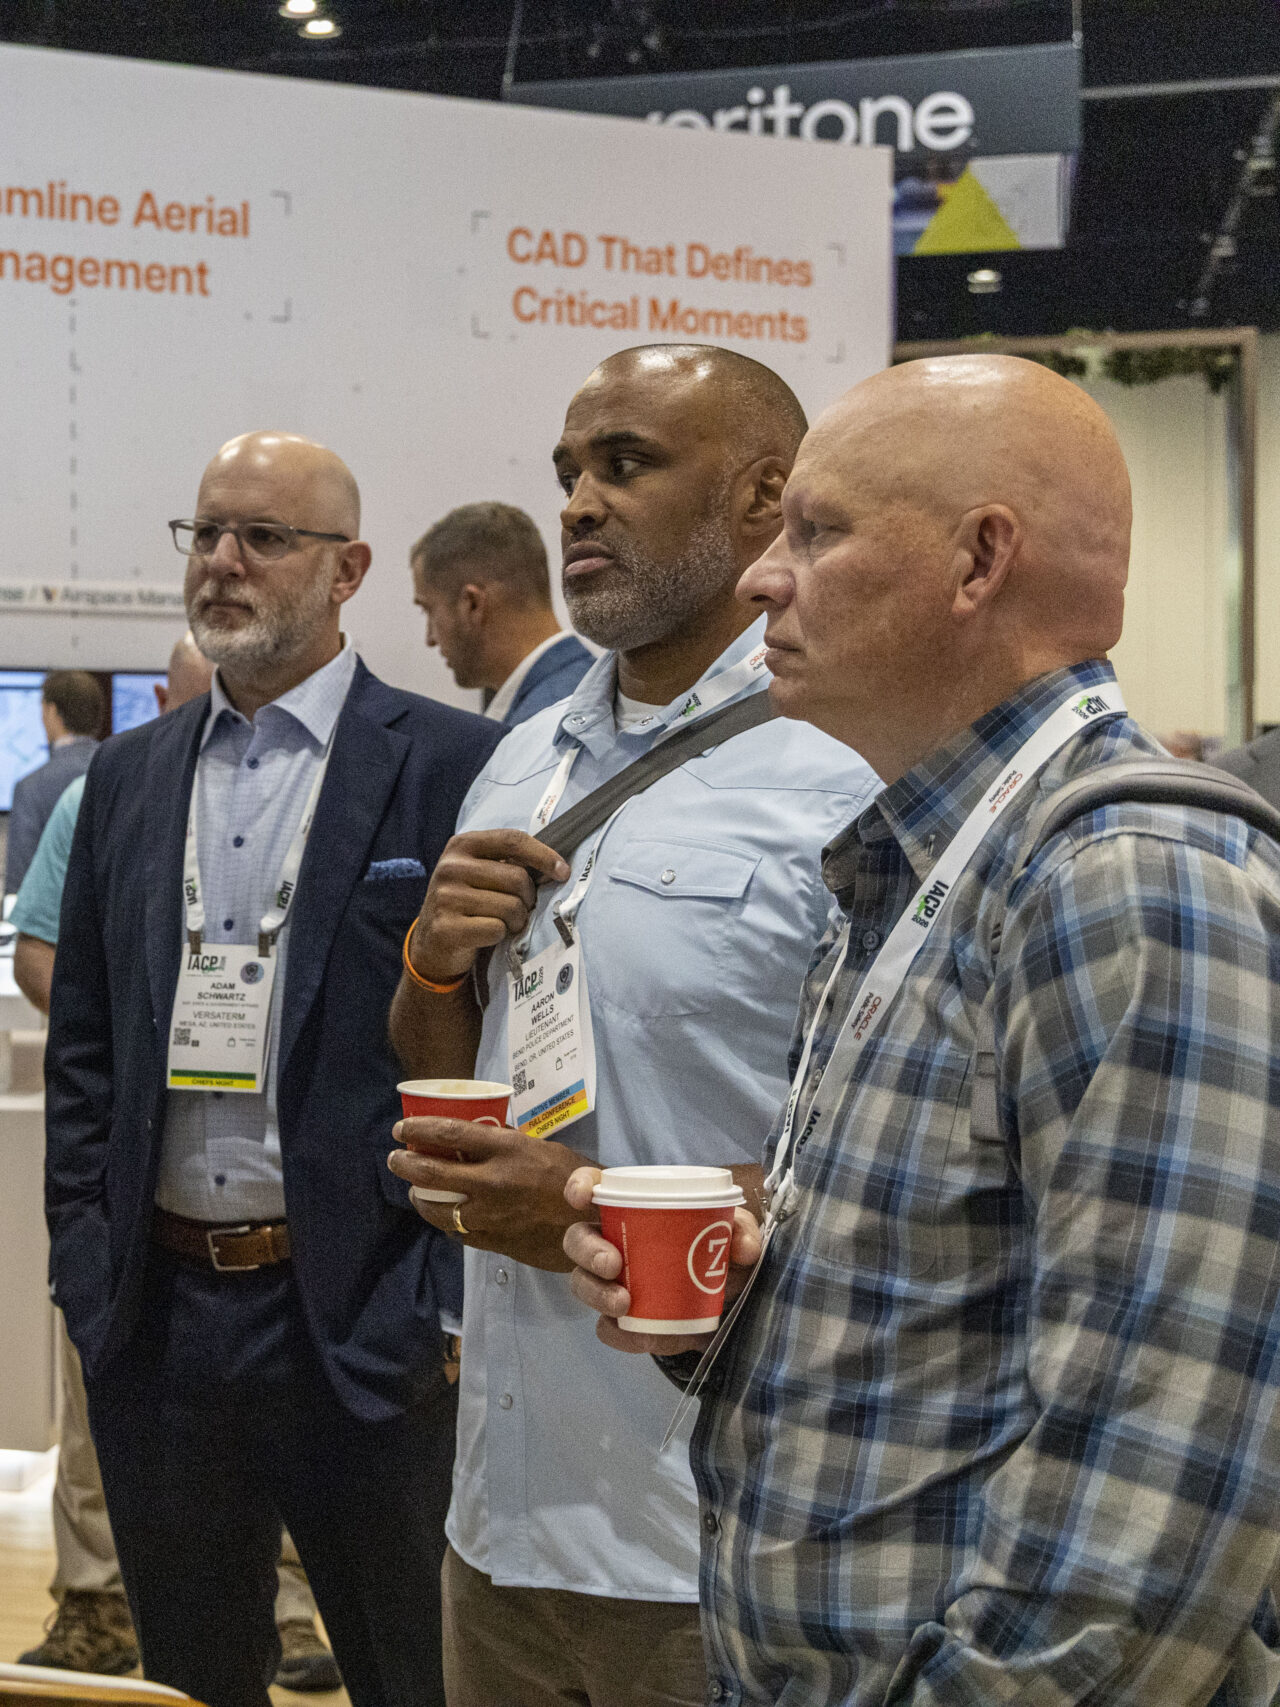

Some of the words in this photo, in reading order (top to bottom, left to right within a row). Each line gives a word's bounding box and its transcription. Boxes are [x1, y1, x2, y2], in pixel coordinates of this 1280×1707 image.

[647, 85, 975, 151] ritone
[133, 190, 250, 238] Aerial
[507, 227, 588, 268] CAD
[598, 235, 677, 275] That
[686, 243, 813, 287] Defines
[512, 286, 641, 330] Critical
[648, 298, 809, 343] Moments
[1086, 696, 1110, 715] IACP
[989, 773, 1023, 813] ORACLE
[925, 880, 949, 918] IACP
[197, 992, 246, 1001] SCHWARTZ
[210, 982, 235, 990] ADAM
[193, 1011, 246, 1020] VERSATERM
[531, 991, 555, 1013] AARON
[531, 1004, 554, 1025] WELLS
[525, 1012, 560, 1041] LIEUTENANT
[854, 996, 882, 1041] ORACLE
[556, 1029, 574, 1045] STATES
[528, 1118, 541, 1128] FULL
[542, 1096, 576, 1120] CONFERENCE
[555, 1110, 570, 1123] NIGHT
[705, 1237, 728, 1278] Z
